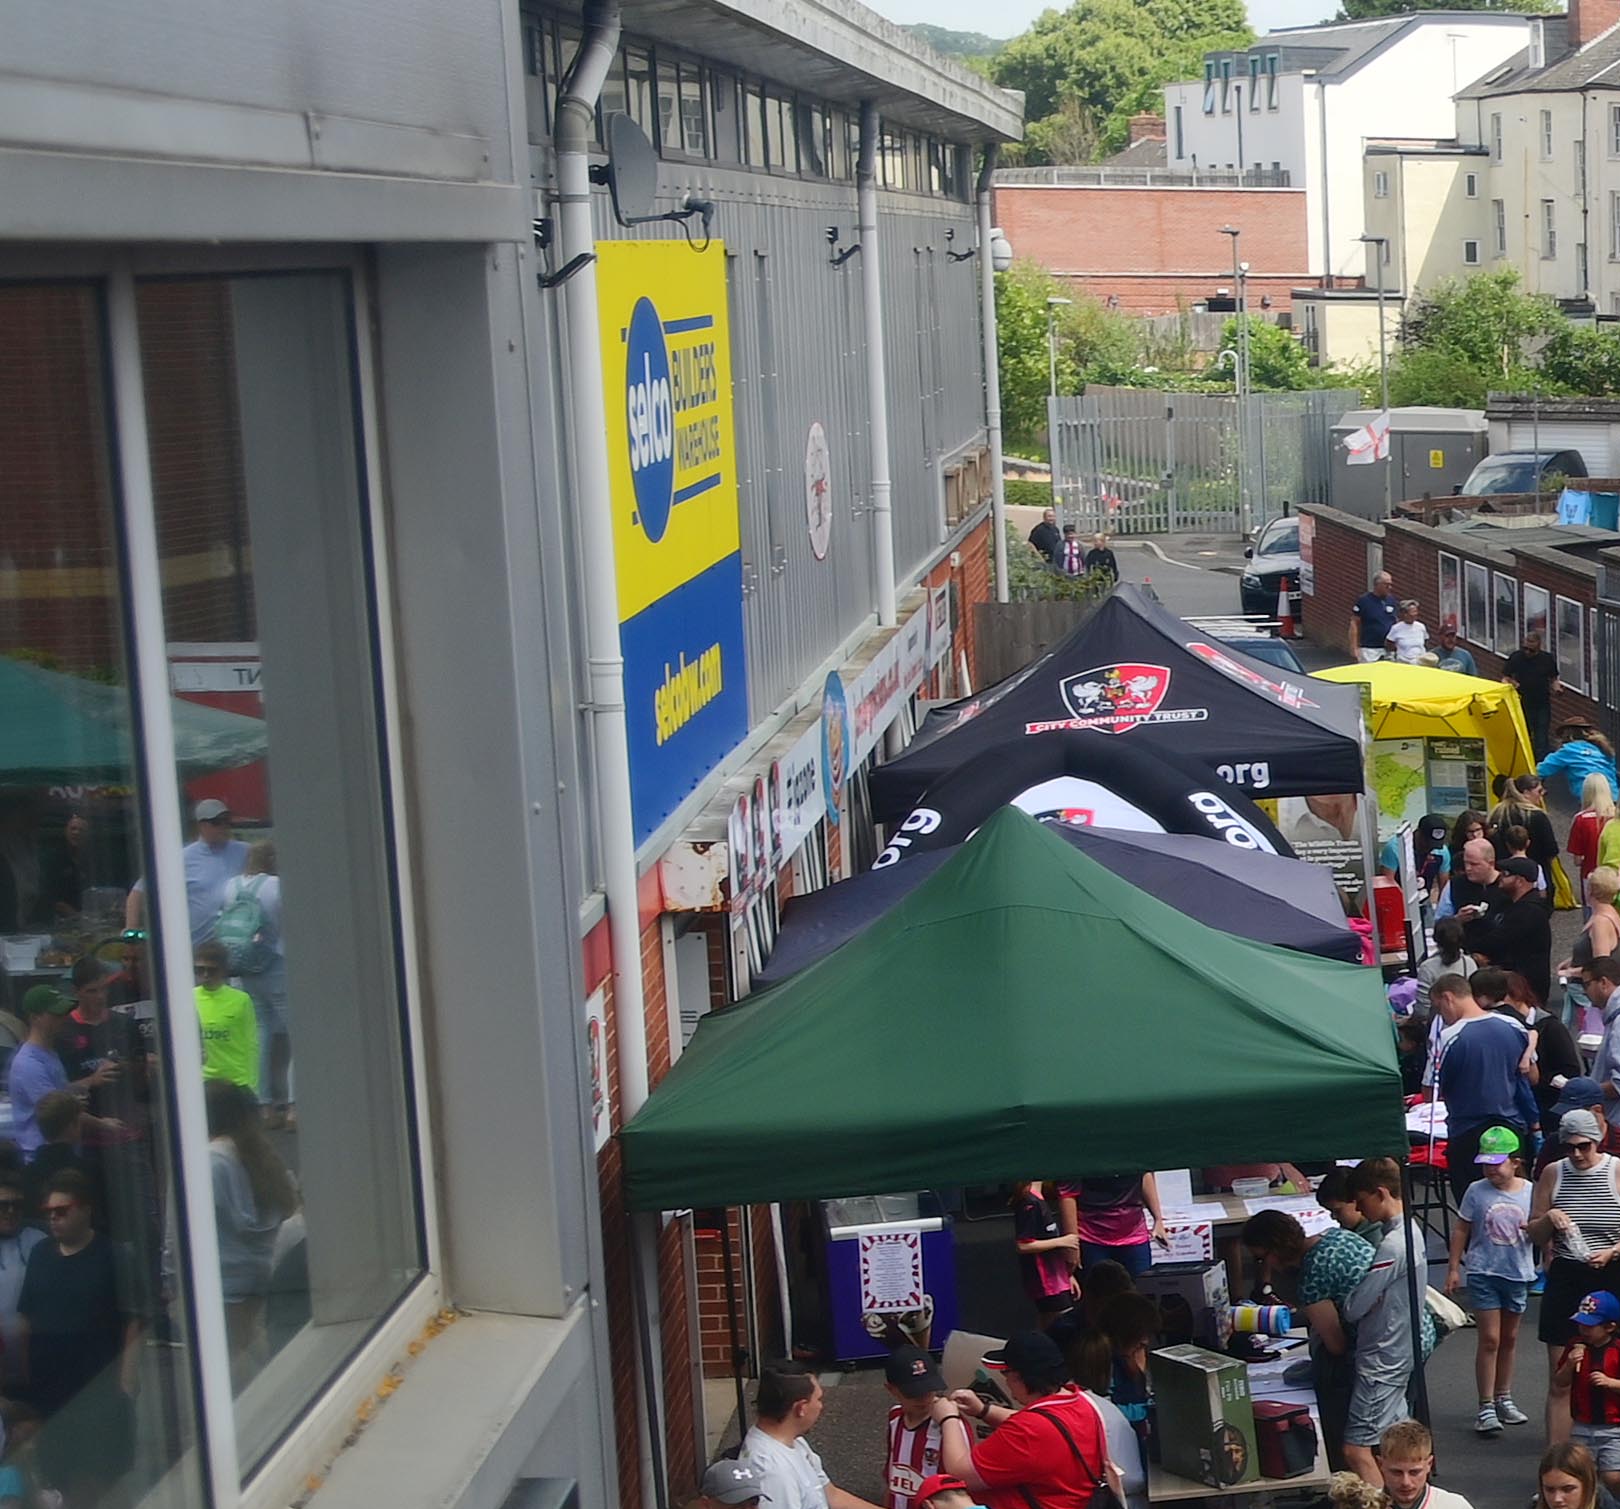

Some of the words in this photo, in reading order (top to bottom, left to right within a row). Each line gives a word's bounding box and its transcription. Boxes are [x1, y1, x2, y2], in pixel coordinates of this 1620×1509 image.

[629, 352, 673, 471] selco
[672, 342, 717, 412] BUILDERS
[1035, 721, 1066, 732] CITY
[1070, 715, 1150, 729] COMMUNITY
[1156, 711, 1198, 721] TRUST
